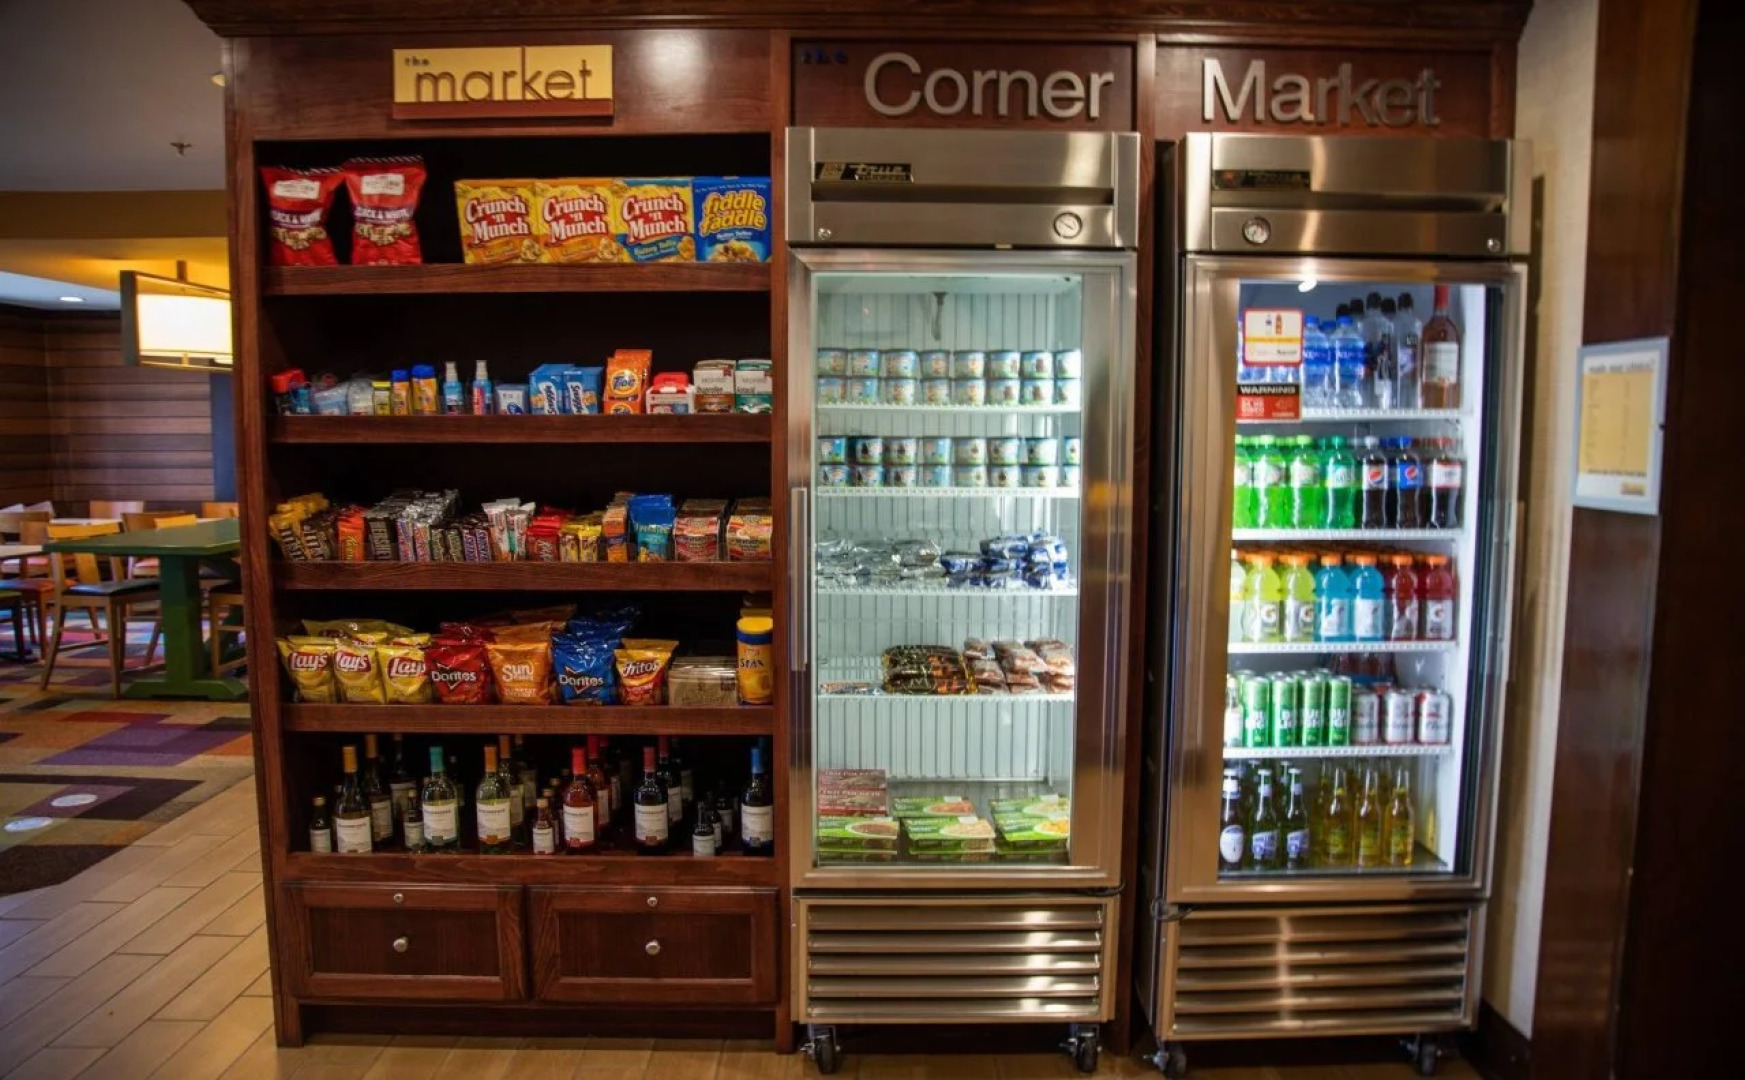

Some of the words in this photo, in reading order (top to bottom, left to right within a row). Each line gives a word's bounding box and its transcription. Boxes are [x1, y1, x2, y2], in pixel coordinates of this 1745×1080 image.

[405, 56, 429, 66] the
[415, 46, 592, 101] market
[865, 53, 1115, 118] Corner
[1202, 57, 1441, 127] Market
[465, 195, 527, 223] Crunch
[543, 195, 606, 222] Crunch
[622, 193, 685, 221] Crunch
[704, 191, 764, 217] fiddle
[473, 217, 530, 244] Munch
[551, 216, 607, 243] Munch
[629, 215, 685, 242] Munch
[1240, 386, 1296, 395] WARNING
[431, 670, 477, 683] Doritos
[502, 663, 534, 682] Sun
[559, 674, 604, 686] Doritos
